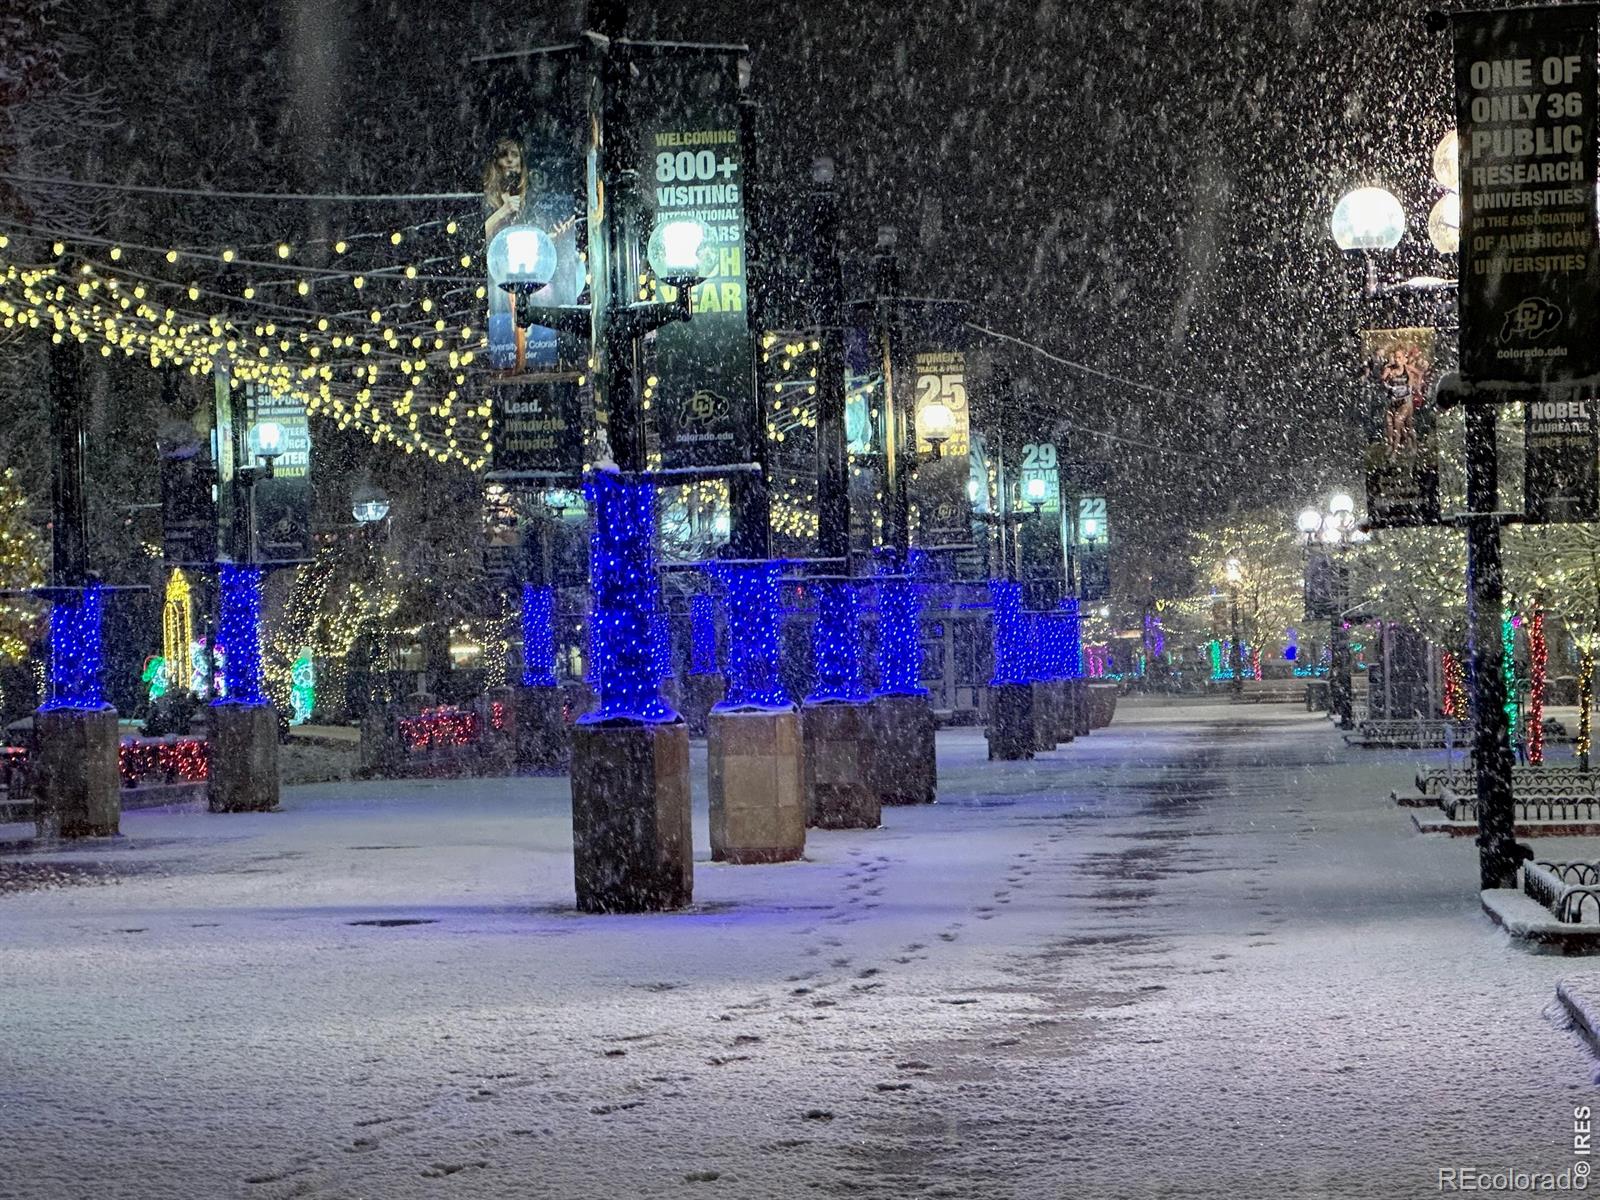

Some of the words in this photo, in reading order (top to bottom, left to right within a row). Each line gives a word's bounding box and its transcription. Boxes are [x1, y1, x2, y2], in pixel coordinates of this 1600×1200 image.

[1470, 59, 1532, 89] ONE
[1542, 56, 1581, 85] OF
[1471, 93, 1541, 123] ONLY
[1547, 92, 1582, 118] 36
[655, 130, 737, 146] WELCOMING
[1471, 125, 1583, 159] PUBLIC
[656, 150, 737, 182] 800+
[1472, 161, 1584, 186] RESEARCH
[656, 183, 739, 207] VISITING
[1472, 188, 1585, 209] UNIVERSITIES
[1488, 216, 1509, 227] THE
[1511, 212, 1585, 226] ASSOCIATION
[1473, 236, 1494, 251] OF
[1500, 231, 1586, 249] AMERICAN
[1474, 254, 1586, 275] UNIVERSITIES
[1497, 346, 1567, 360] colorado.edu
[917, 374, 966, 410] 25
[504, 400, 542, 413] Lead.
[1531, 402, 1588, 419] NOBEL
[676, 432, 734, 441] colorado.edu
[1532, 422, 1590, 433] LAUREATES
[950, 444, 967, 456] 3.0
[1532, 437, 1562, 448] SINCE
[257, 452, 307, 466] NTER
[1022, 443, 1057, 469] 29
[1024, 469, 1058, 481] TEAM
[1080, 498, 1107, 518] 22
